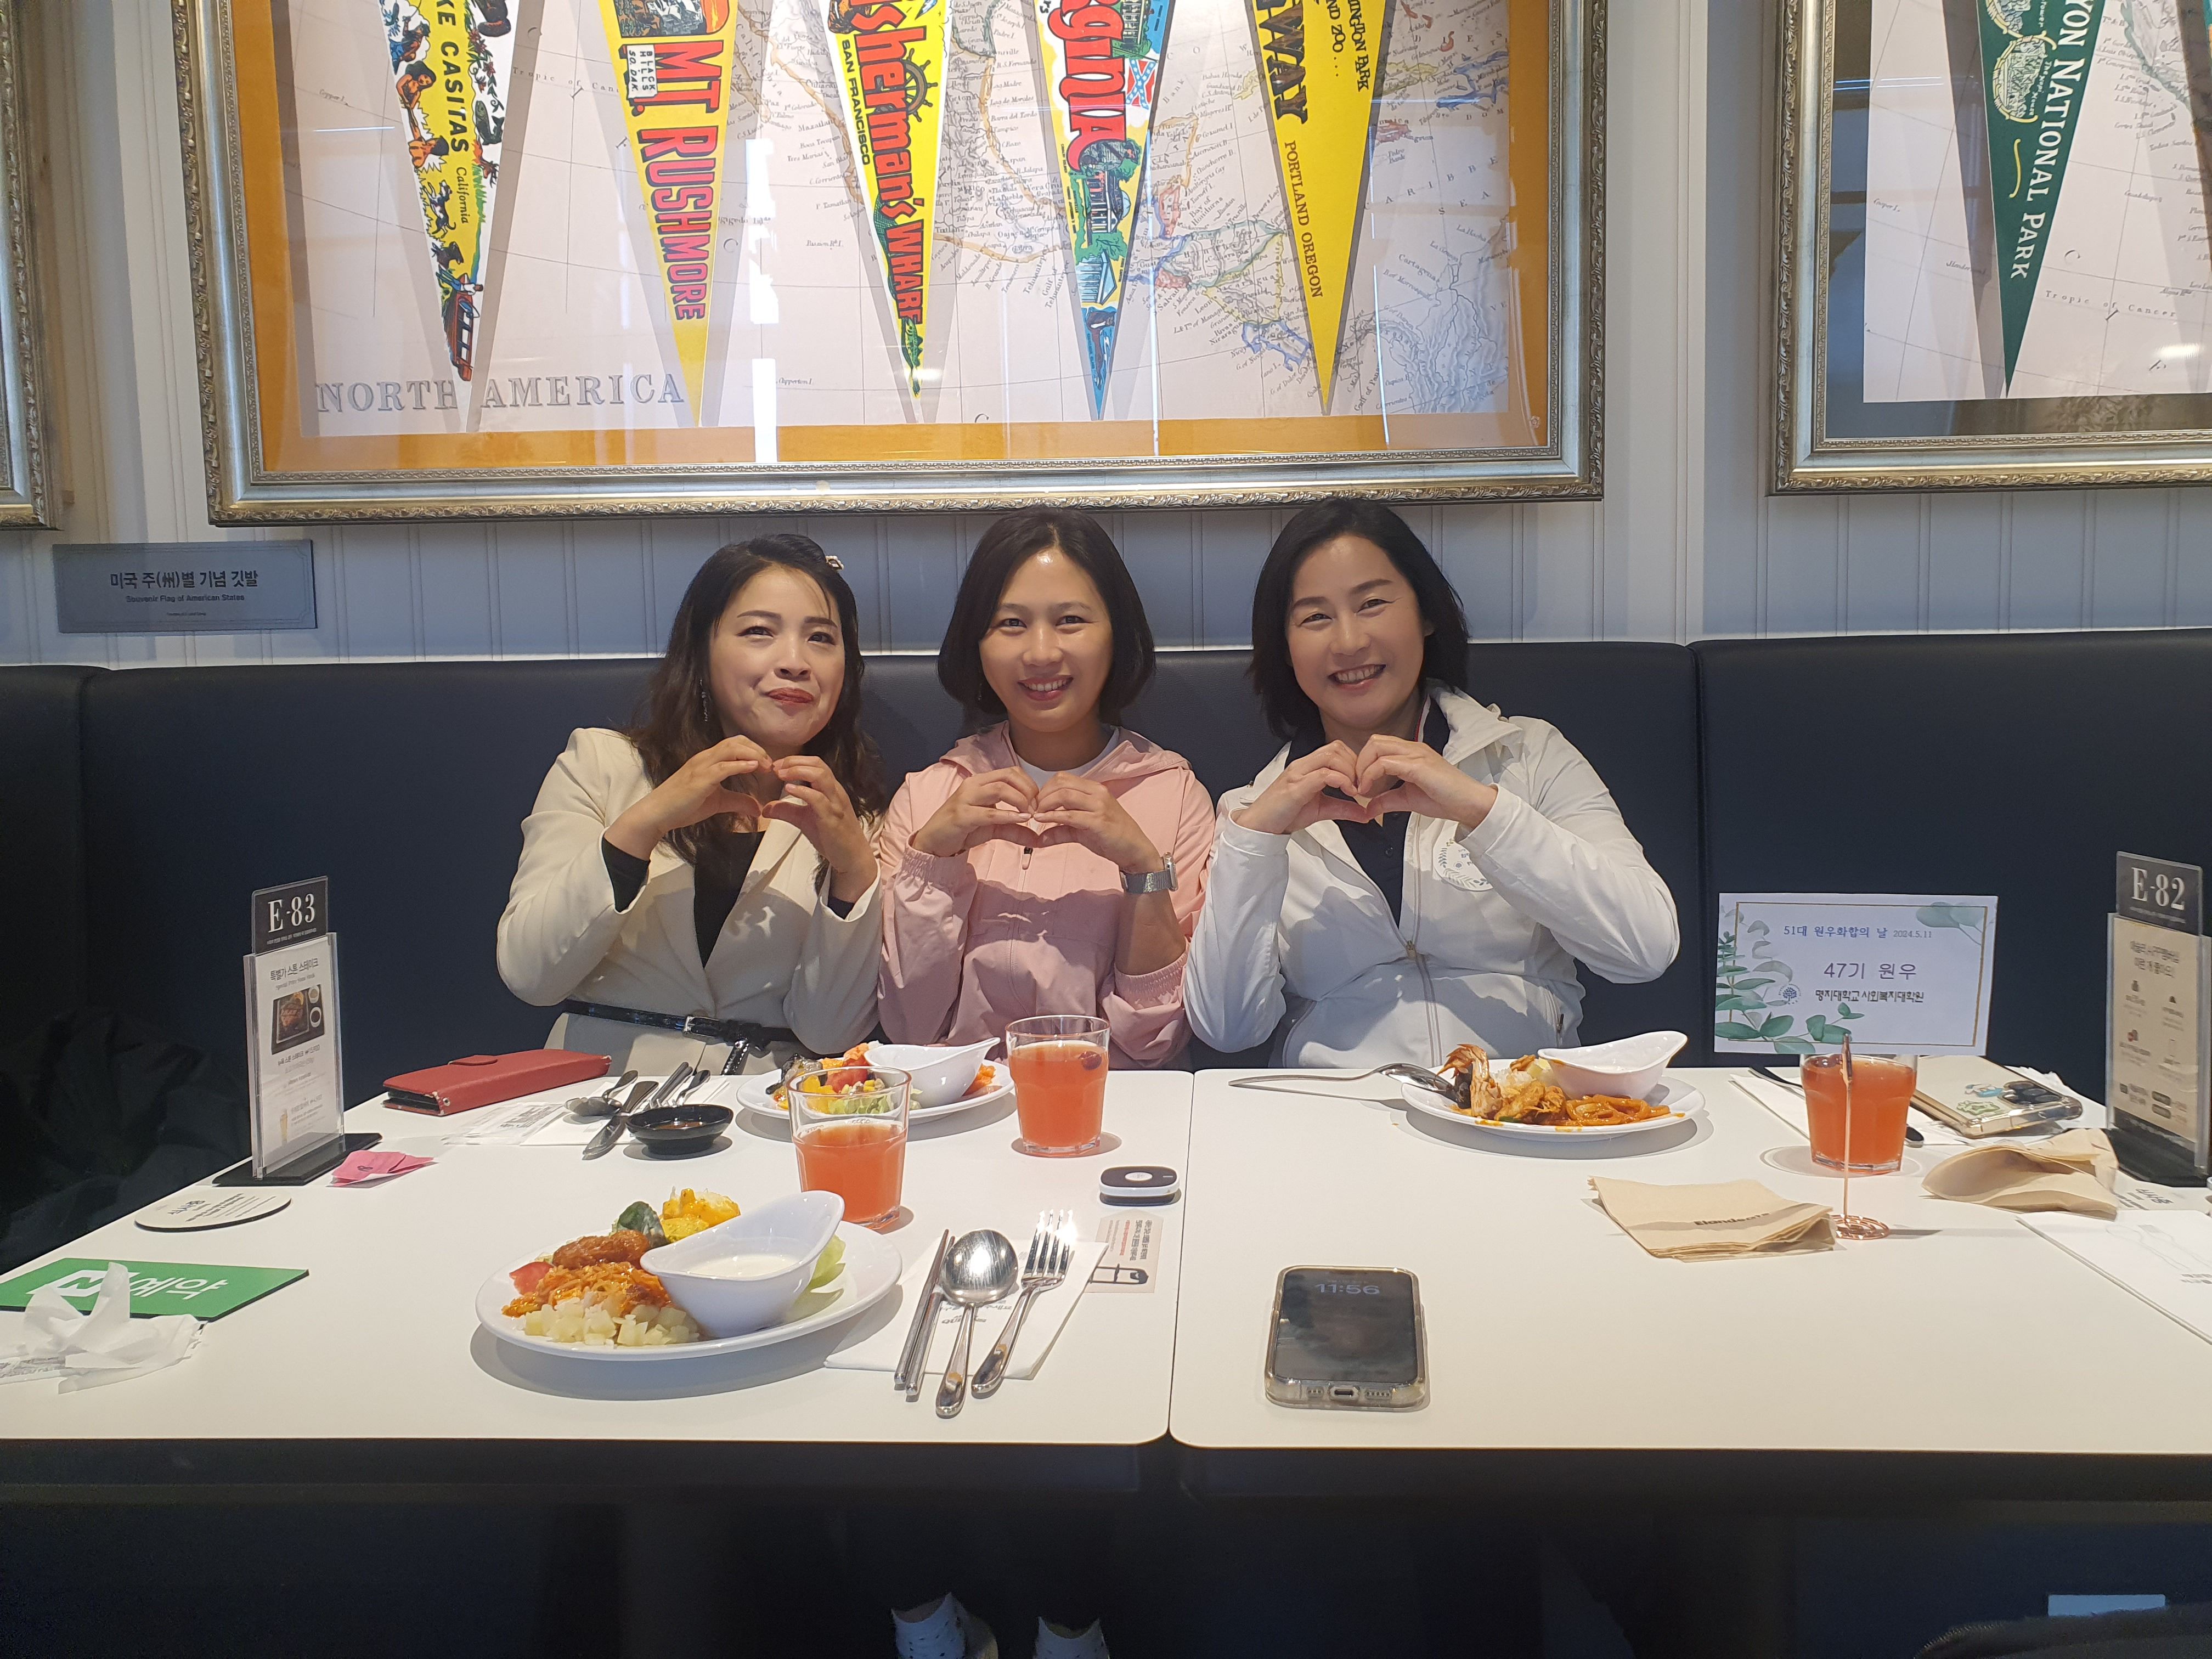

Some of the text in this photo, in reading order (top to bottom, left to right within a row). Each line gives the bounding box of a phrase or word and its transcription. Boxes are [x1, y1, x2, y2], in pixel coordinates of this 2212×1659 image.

[512, 67, 555, 82] Tropic
[639, 50, 649, 91] HILLS
[646, 50, 656, 91] BLACK
[1355, 54, 1370, 93] PARK
[440, 41, 469, 153] CASITAS
[841, 39, 871, 165] SAN FRANCISCO
[1162, 78, 1185, 104] Bank
[2025, 58, 2086, 202] NATIONAL
[455, 166, 469, 224] California
[1189, 205, 1203, 218] Bay
[636, 125, 719, 320] RUSHMORE
[1284, 140, 1324, 298] PORTLAND OREGON
[2010, 211, 2046, 279] PARK
[884, 218, 924, 325] WHARF
[1042, 276, 1054, 296] Gulf
[2045, 290, 2090, 304] Tropic
[2128, 304, 2177, 317] Cancer
[316, 374, 685, 412] NORTH AMERICA
[110, 570, 258, 589] 미국 주(州)별 기념 깃발
[160, 595, 175, 603] Flag
[2131, 867, 2186, 911] E-82
[267, 893, 315, 933] E-83
[1784, 926, 1933, 939] 51대 원우화합의 날 2024.5.11
[1824, 962, 1918, 980] 47기 원우
[1815, 990, 1925, 1003] 명지대학교 사회복지대학원
[1315, 1283, 1380, 1295] 11:56
